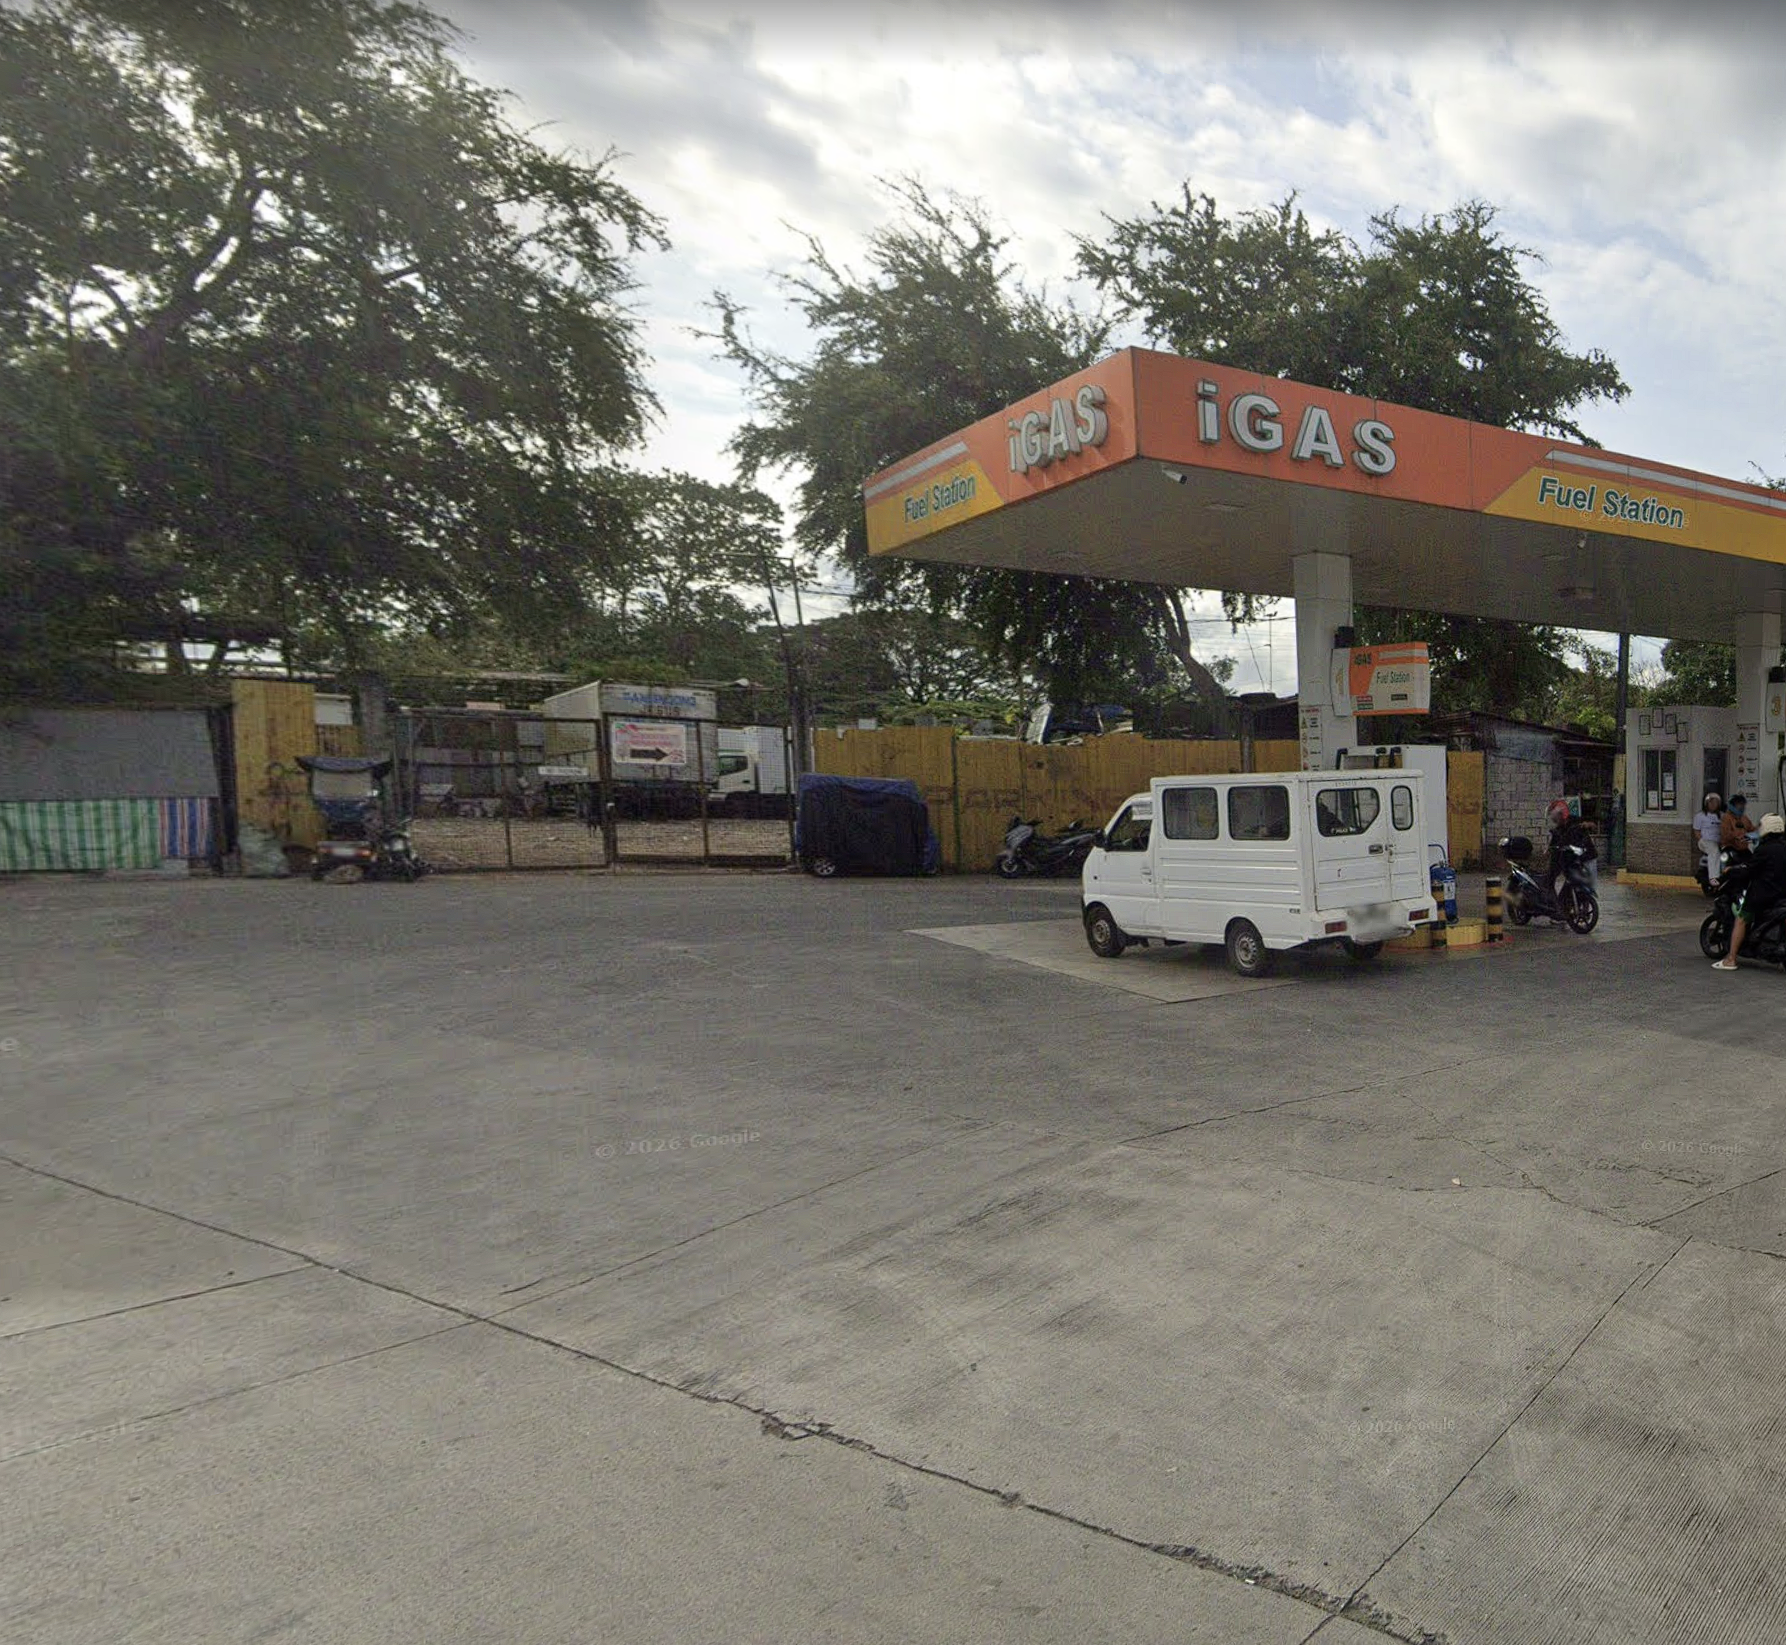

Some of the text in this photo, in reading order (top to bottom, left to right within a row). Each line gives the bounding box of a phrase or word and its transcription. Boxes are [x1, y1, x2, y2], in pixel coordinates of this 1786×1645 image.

[1008, 384, 1108, 474] iGAS
[1197, 378, 1397, 477] iGAS
[902, 473, 977, 525] Fuel Station
[1538, 475, 1597, 512] Fuel
[1602, 489, 1684, 529] Station
